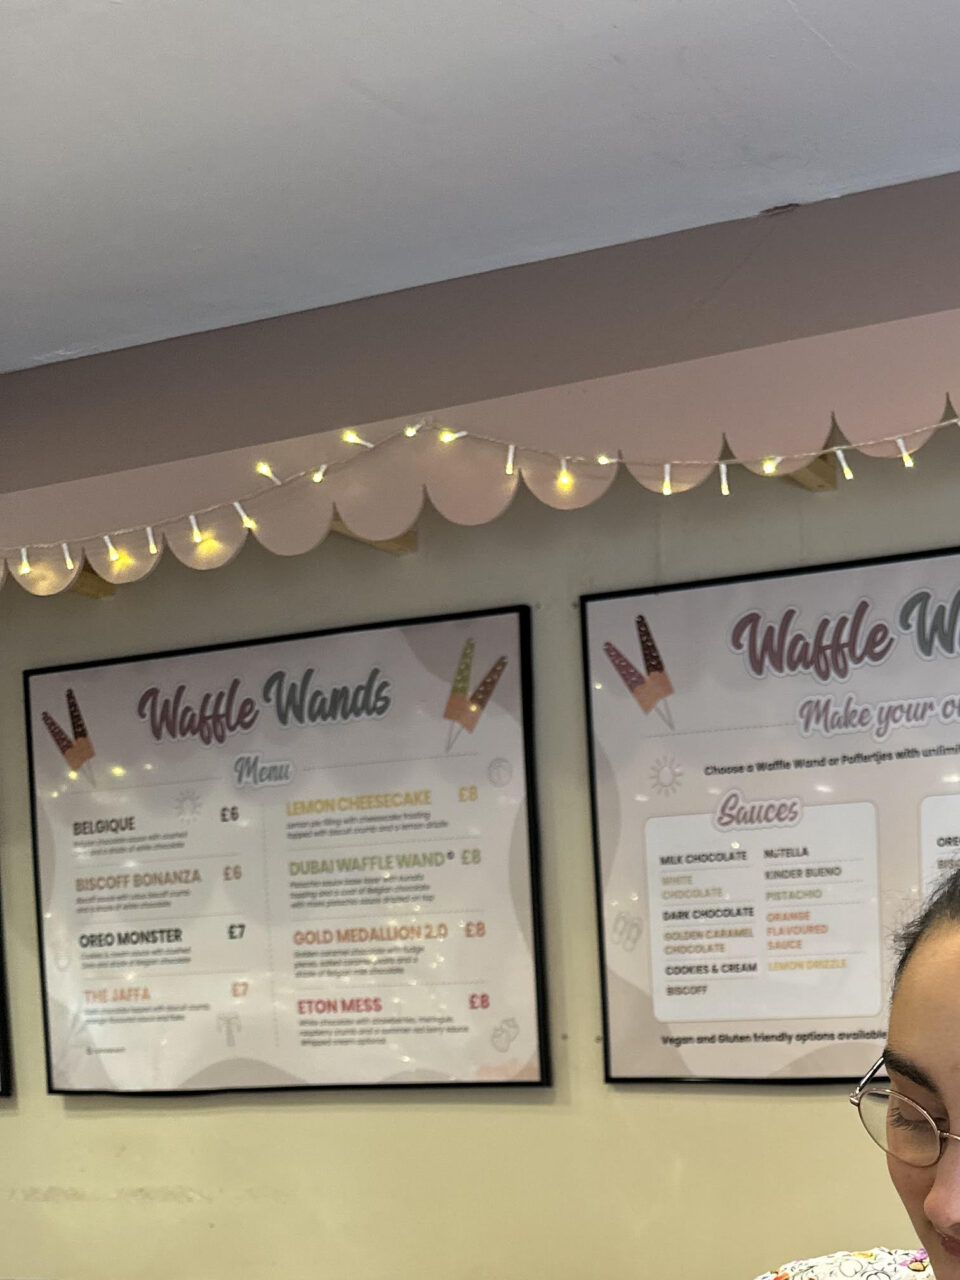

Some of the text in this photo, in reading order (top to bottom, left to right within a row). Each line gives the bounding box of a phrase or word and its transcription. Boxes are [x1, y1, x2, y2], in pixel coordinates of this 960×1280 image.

[732, 600, 895, 681] Waffle
[138, 668, 391, 745] Waffle Wands
[800, 698, 872, 733] Make
[877, 698, 935, 738] your
[234, 756, 290, 785] Menu
[704, 763, 745, 777] Choose
[747, 764, 755, 774] a
[756, 757, 792, 772] Waffle
[794, 755, 826, 769] Wand
[828, 756, 839, 767] or
[895, 746, 920, 760] with
[286, 785, 478, 816] LEMON CHEESECAKE £8
[717, 792, 799, 828] Sauces
[73, 806, 239, 836] BELGIQUE £6
[289, 848, 481, 876] DUBAI WAFFLE WAND £8
[660, 851, 747, 866] MILK CHOCOLATE
[75, 865, 242, 892] BISCOFF BONANZA £6
[765, 867, 842, 880] KINDER BUENO
[661, 888, 723, 900] CHOCOLATE
[766, 889, 823, 901] PISTACHIO
[663, 907, 754, 921] DARK CHOCOLATE
[79, 924, 246, 948] OREO MONSTER £7
[293, 921, 486, 945] GOLD MEDALLION 2.0 £8
[706, 927, 754, 939] CARAMEL
[664, 943, 725, 955] CHOCOLATE
[665, 964, 709, 976] COOKIES
[721, 963, 757, 974] CREAM
[84, 982, 248, 1002] THE JAFFA £7
[666, 985, 708, 996] BISCOFF
[297, 993, 490, 1014] ETON MESS £8
[662, 1029, 888, 1048] Vegan and Gluten friendly options available
